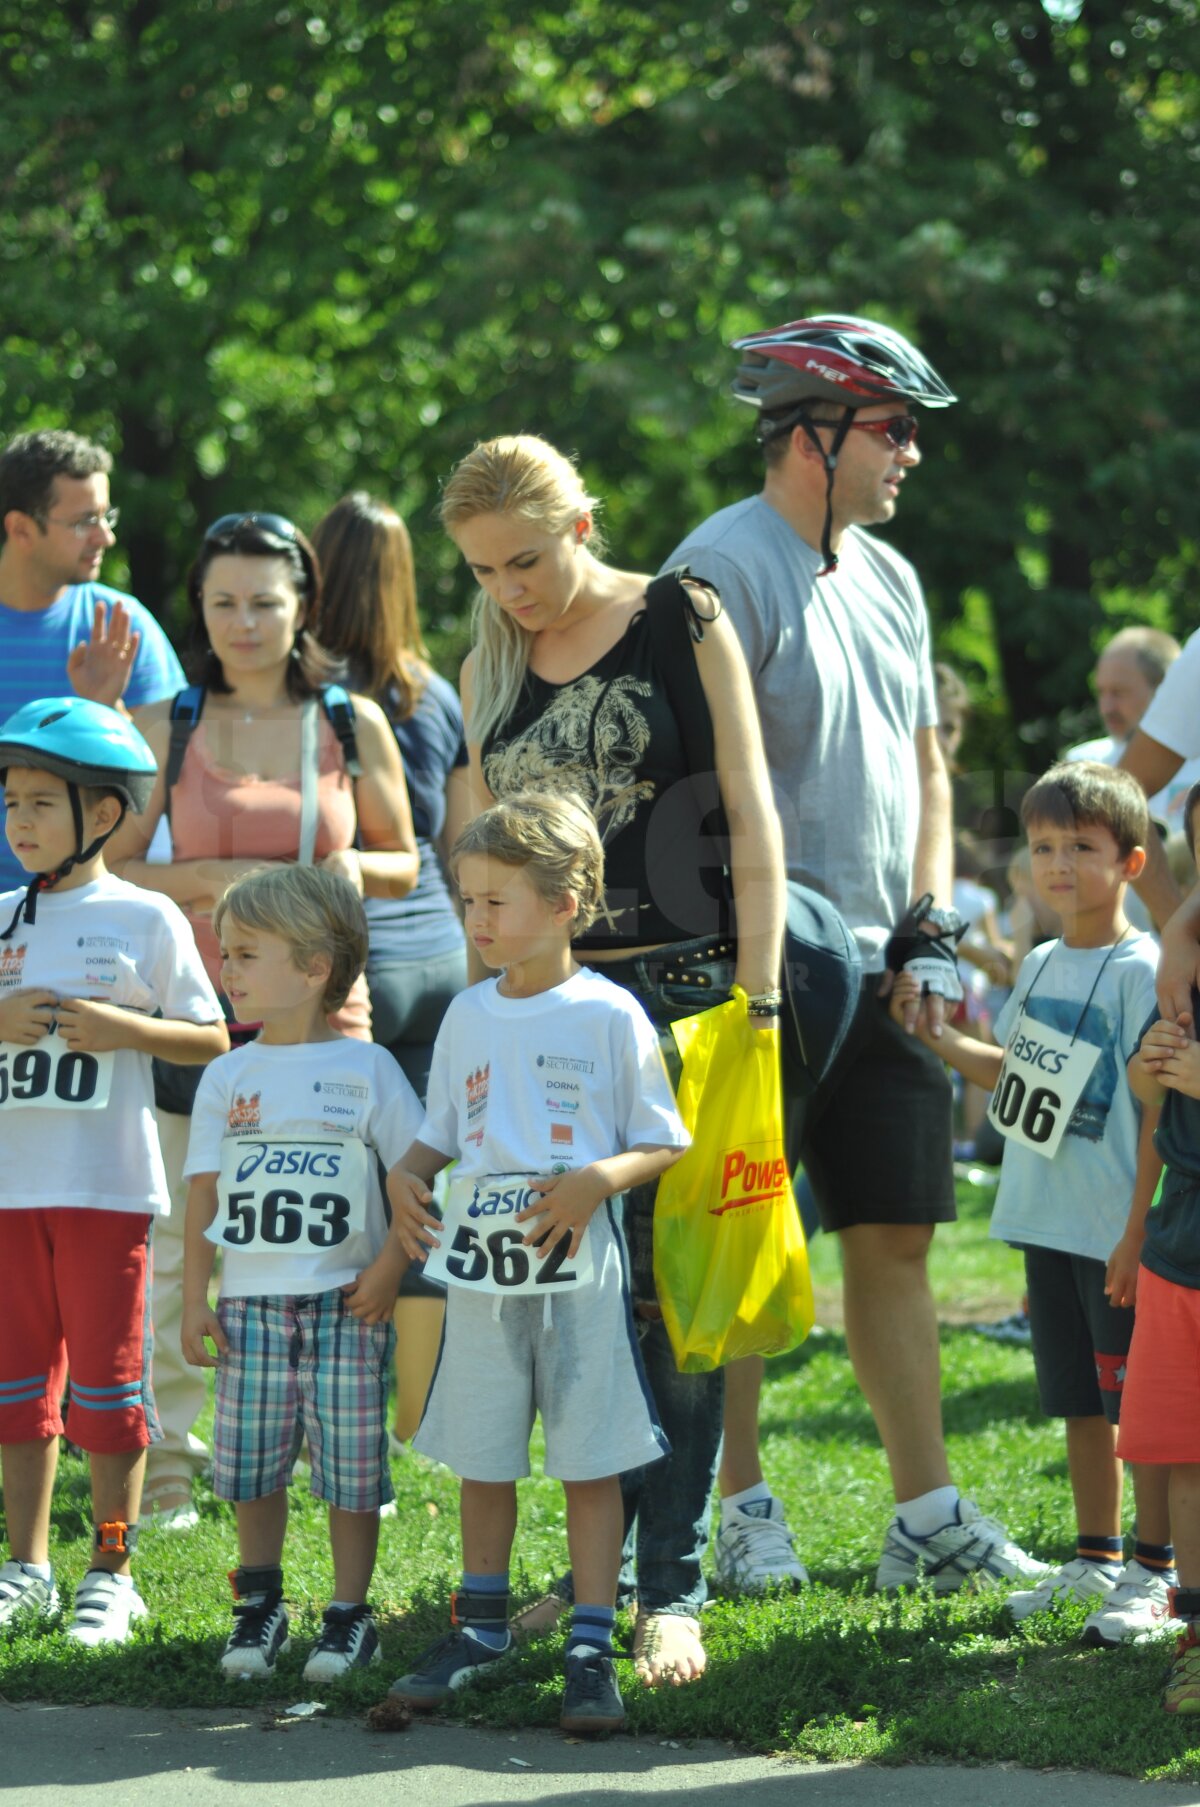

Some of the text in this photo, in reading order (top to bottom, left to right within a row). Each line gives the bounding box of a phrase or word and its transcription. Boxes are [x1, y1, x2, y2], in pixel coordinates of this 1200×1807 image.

[806, 359, 850, 383] MET
[0, 1048, 99, 1103] 90
[546, 1080, 579, 1092] DORNA
[323, 1104, 356, 1116] DORNA
[265, 1149, 342, 1178] asics
[223, 1188, 350, 1247] 563
[446, 1224, 577, 1287] 562
